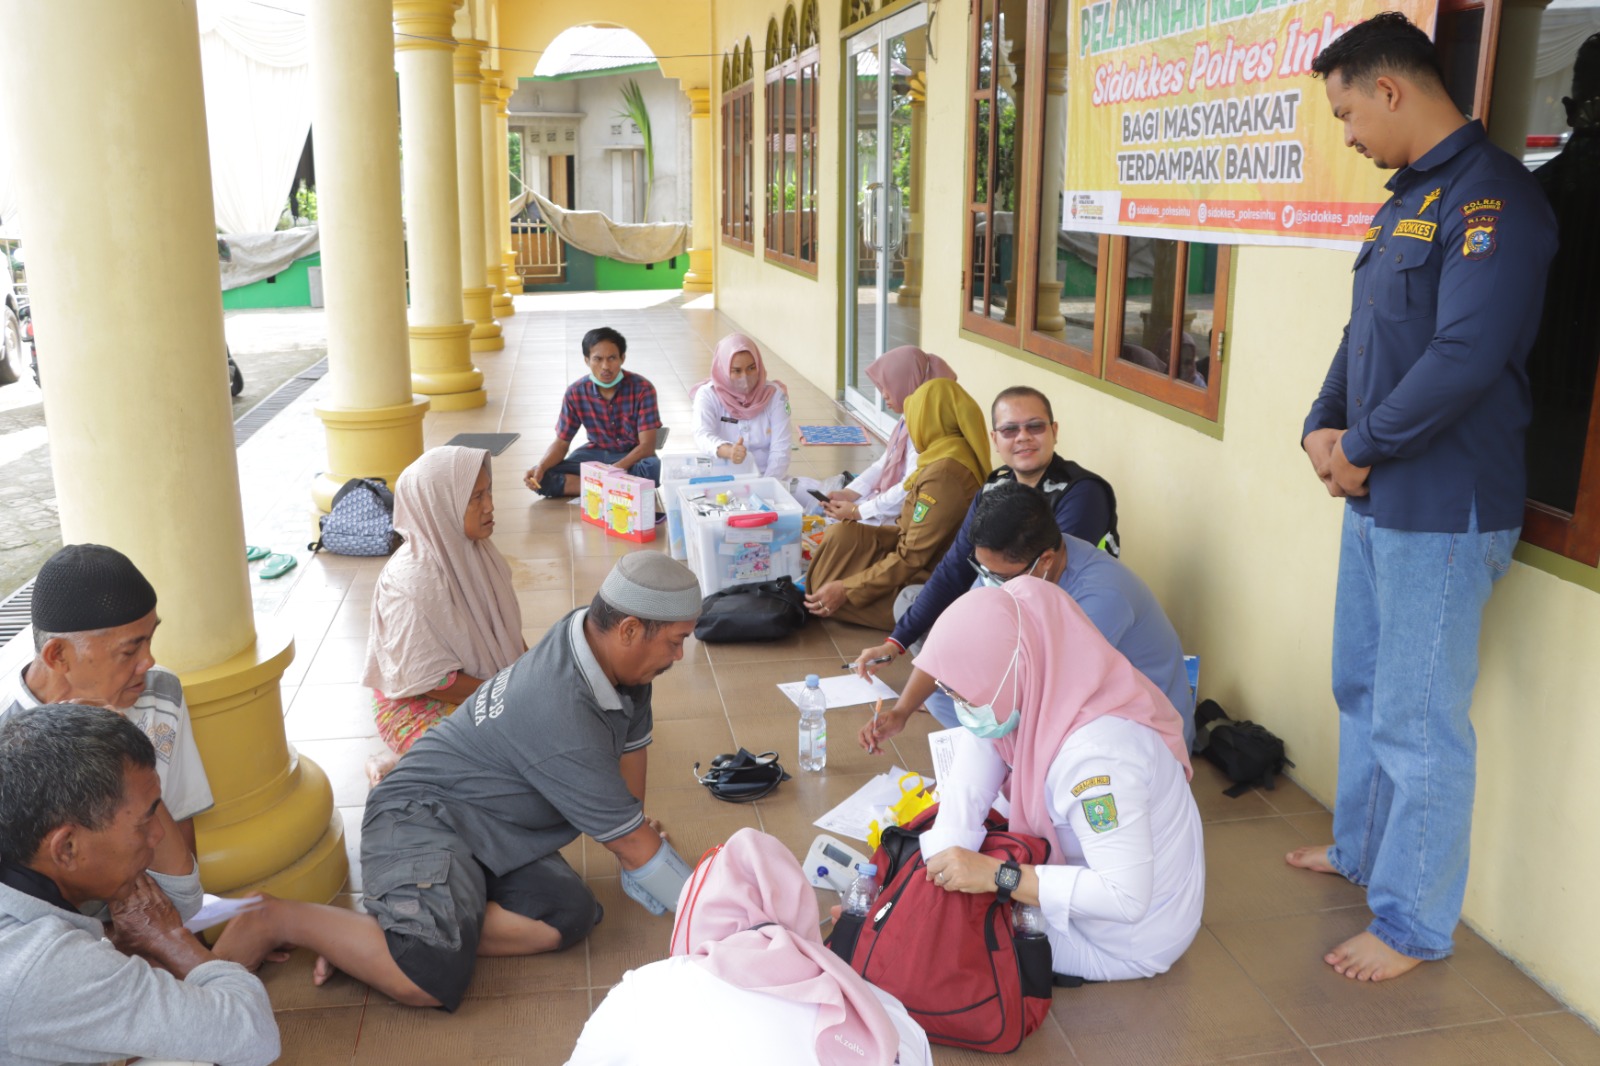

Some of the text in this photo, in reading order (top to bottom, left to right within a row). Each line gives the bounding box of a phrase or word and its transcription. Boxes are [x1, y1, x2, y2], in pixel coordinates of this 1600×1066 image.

[1080, 0, 1205, 58] PELAYANAN
[1093, 55, 1186, 105] Sidokkes
[1188, 37, 1278, 90] Polres
[1123, 93, 1300, 143] BAGI MASYARAKAT
[1118, 144, 1302, 182] TERDAMPAK BANJIR
[1463, 198, 1502, 212] POLRES
[1207, 208, 1277, 223] sidokkes_polresinhu
[1295, 209, 1375, 227] @sidokkes_polres
[1467, 216, 1495, 224] RIAU
[1397, 221, 1431, 237] SIDOKKES
